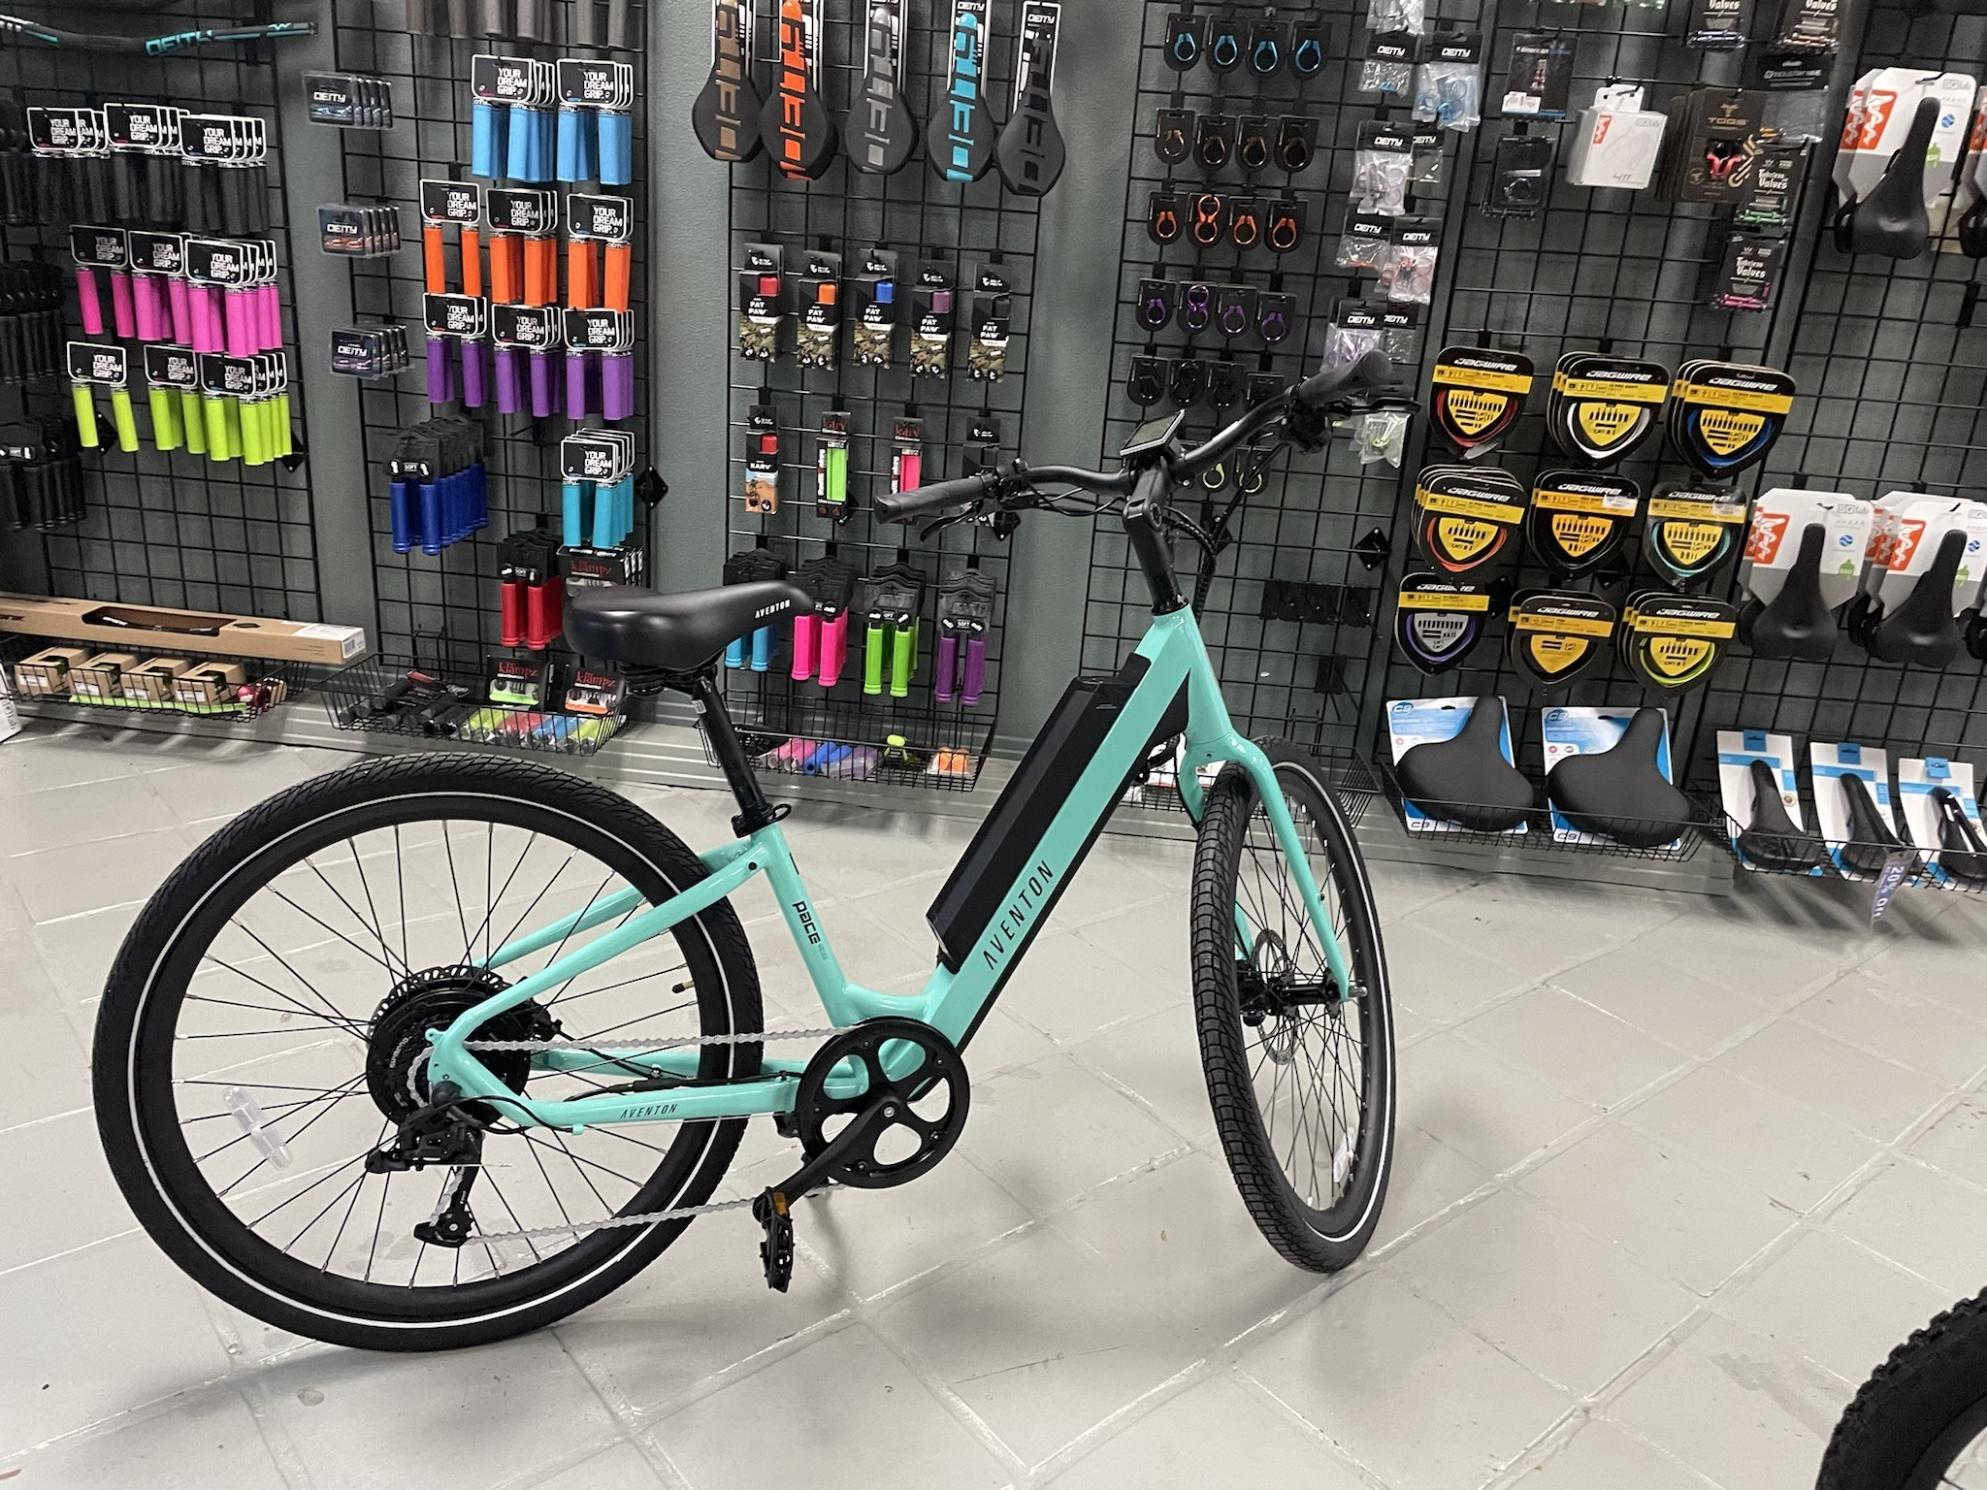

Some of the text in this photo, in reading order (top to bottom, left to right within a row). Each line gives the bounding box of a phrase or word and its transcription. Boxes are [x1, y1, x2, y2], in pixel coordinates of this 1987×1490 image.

[498, 68, 521, 78] YOUR
[584, 71, 607, 82] YOUR
[497, 77, 527, 88] DREAM
[584, 80, 613, 91] DREAM
[49, 118, 69, 128] YOUR
[130, 114, 150, 124] YOUR
[51, 127, 76, 137] DREAM
[130, 123, 157, 133] DREAM
[203, 128, 224, 138] YOUR
[203, 136, 231, 146] DREAM
[447, 191, 470, 202] YOUR
[447, 200, 476, 211] DREAM
[510, 200, 532, 211] YOUR
[511, 209, 539, 219] DREAM
[593, 207, 616, 218] YOUR
[593, 216, 622, 227] DREAM
[96, 236, 116, 245] YOUR
[96, 244, 123, 254] DREAM
[153, 243, 173, 252] YOUR
[153, 251, 179, 261] DREAM
[211, 253, 233, 264] YOUR
[211, 261, 239, 272] DREAM
[447, 305, 468, 315] YOUR
[447, 313, 474, 323] DREAM
[516, 315, 538, 326] YOUR
[516, 324, 544, 334] DREAM
[587, 319, 608, 329] YOUR
[587, 327, 615, 337] DREAM
[93, 354, 116, 364] YOUR
[167, 356, 187, 365] YOUR
[93, 361, 122, 372] DREAM
[167, 363, 193, 374] DREAM
[1454, 358, 1518, 372] JAGWIRE
[225, 366, 245, 375] YOUR
[1586, 369, 1652, 382] JAGWIRE
[225, 373, 251, 383] DREAM
[1708, 377, 1778, 391] JAGWIRE
[585, 451, 606, 460] YOUR
[585, 459, 612, 468] DREAM
[1557, 483, 1622, 496] JAGWIRE
[1447, 487, 1511, 503] JAGWIRE
[754, 599, 791, 619] AVENTON
[1537, 606, 1599, 619] JAGWIRE
[1656, 608, 1720, 619] JAGWIRE
[983, 859, 1054, 971] AVENTON
[620, 1104, 678, 1120] AVENTON
